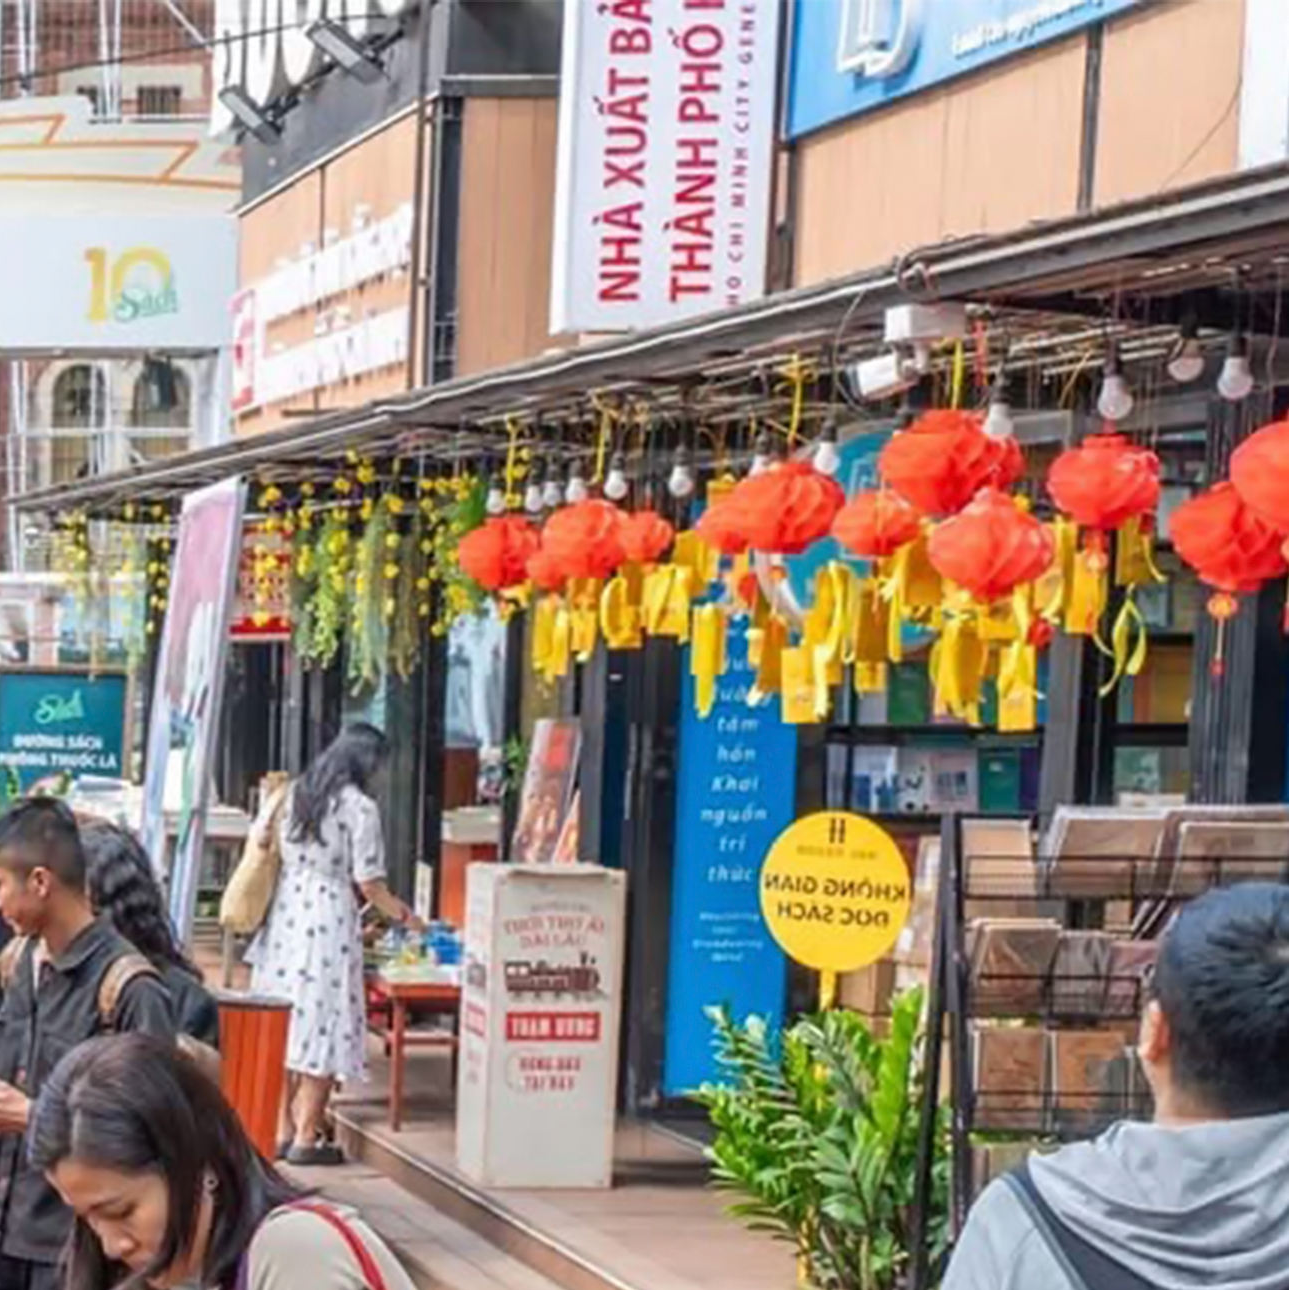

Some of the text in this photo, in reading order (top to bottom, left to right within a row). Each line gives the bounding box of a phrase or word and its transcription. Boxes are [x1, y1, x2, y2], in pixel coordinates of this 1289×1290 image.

[667, 24, 725, 123] PHỐ
[734, 80, 751, 134] CITY
[593, 68, 650, 189] XUẤT
[731, 148, 749, 208] MINH
[592, 202, 644, 302] NHÀ
[663, 139, 719, 303] THÀNH
